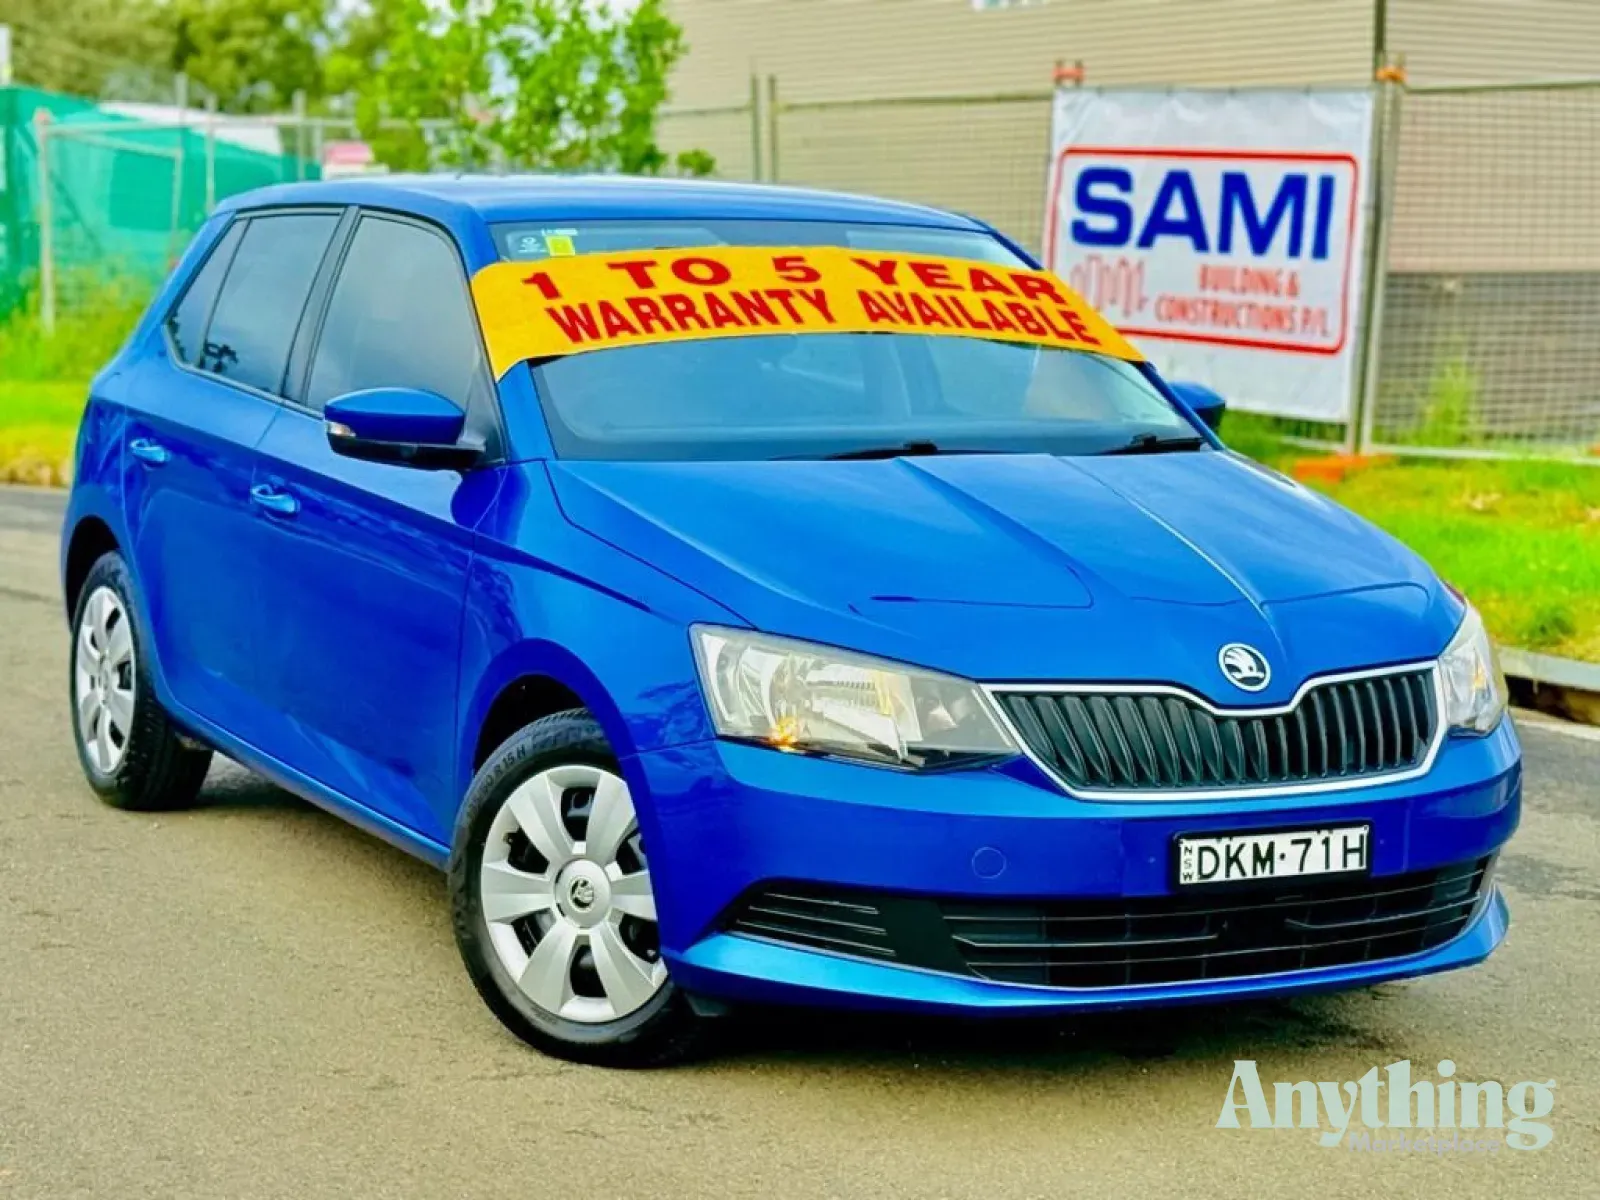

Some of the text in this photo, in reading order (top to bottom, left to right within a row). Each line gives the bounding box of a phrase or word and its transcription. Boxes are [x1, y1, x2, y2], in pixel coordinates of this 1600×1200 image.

[1071, 166, 1336, 260] SAMI
[522, 255, 1068, 305] 1 TO 5 YEAR
[1199, 264, 1299, 298] BUILDING &
[544, 288, 1103, 346] WARRANTY AVAILABLE
[1155, 293, 1297, 333] CONSTRUCTIONS
